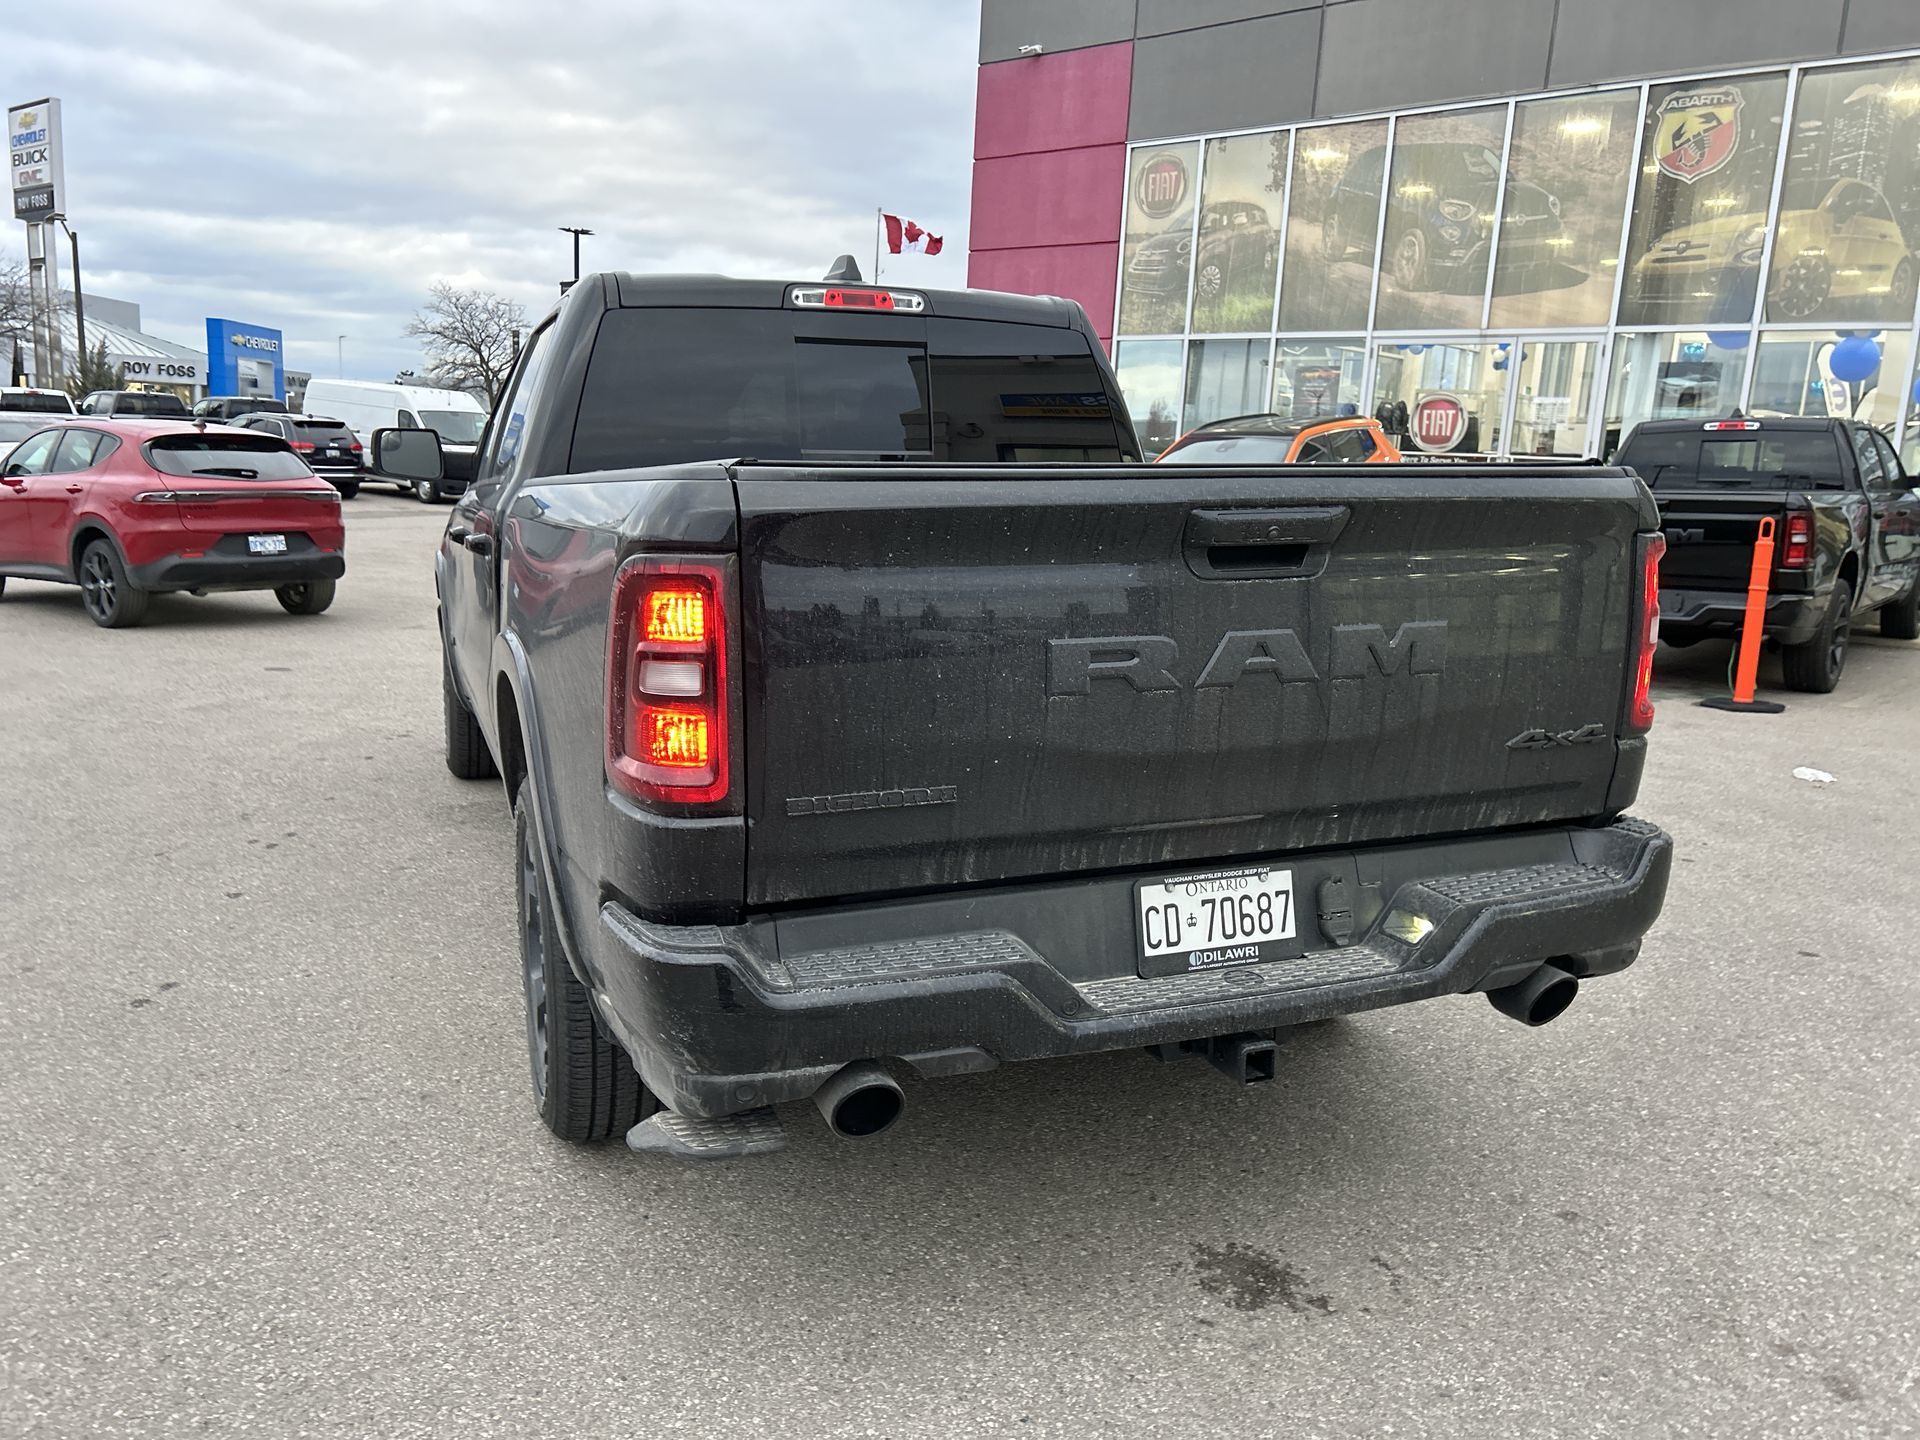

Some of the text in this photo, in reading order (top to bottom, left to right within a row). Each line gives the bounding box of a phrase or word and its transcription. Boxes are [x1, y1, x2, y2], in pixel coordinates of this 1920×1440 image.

[1667, 95, 1733, 109] ABARTH
[12, 129, 46, 147] CHEVROLET
[13, 148, 47, 167] BUICK
[19, 169, 43, 185] GMC
[1148, 171, 1178, 202] FIAT
[17, 194, 48, 209] ROY FOSS
[245, 336, 279, 351] CHEVROLET
[122, 361, 196, 378] ROY FOSS
[1421, 410, 1456, 436] FIAT
[1045, 620, 1448, 699] RAM
[1164, 875, 1192, 884] VAUGHAN
[1193, 872, 1222, 881] CHRYSLER
[1186, 877, 1248, 897] ONTARIO
[1145, 890, 1290, 950] CD 70687
[1203, 945, 1259, 963] DILAWRI
